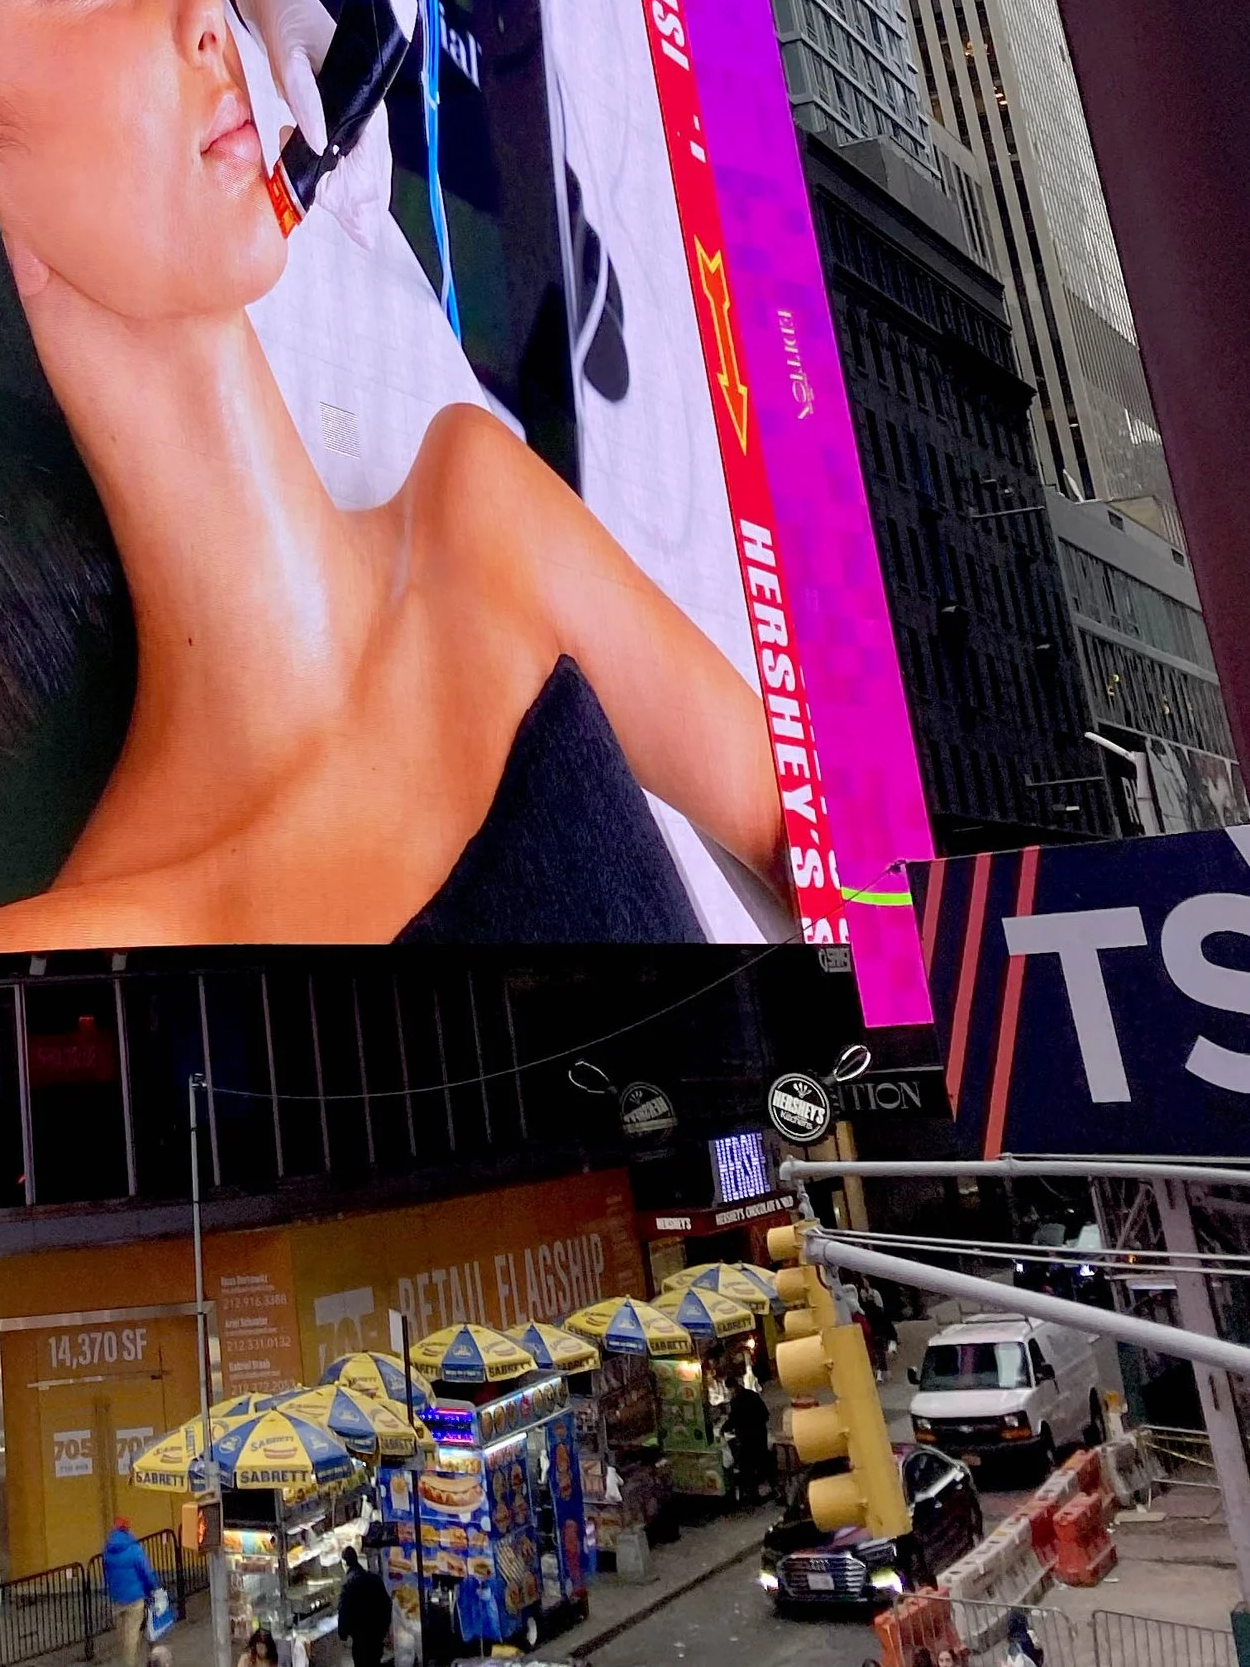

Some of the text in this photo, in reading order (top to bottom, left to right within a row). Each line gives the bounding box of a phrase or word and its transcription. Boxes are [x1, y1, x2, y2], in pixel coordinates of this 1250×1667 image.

[739, 517, 824, 891] HERSHEY'S
[837, 1081, 922, 1111] ITION
[398, 1260, 491, 1346] RETAIL
[494, 1232, 604, 1331] FLAGSHIP
[48, 1328, 148, 1370] 14,370 SF
[54, 1438, 95, 1462] 705
[136, 1471, 185, 1487] SABRETT
[240, 1470, 308, 1485] SABRETT
